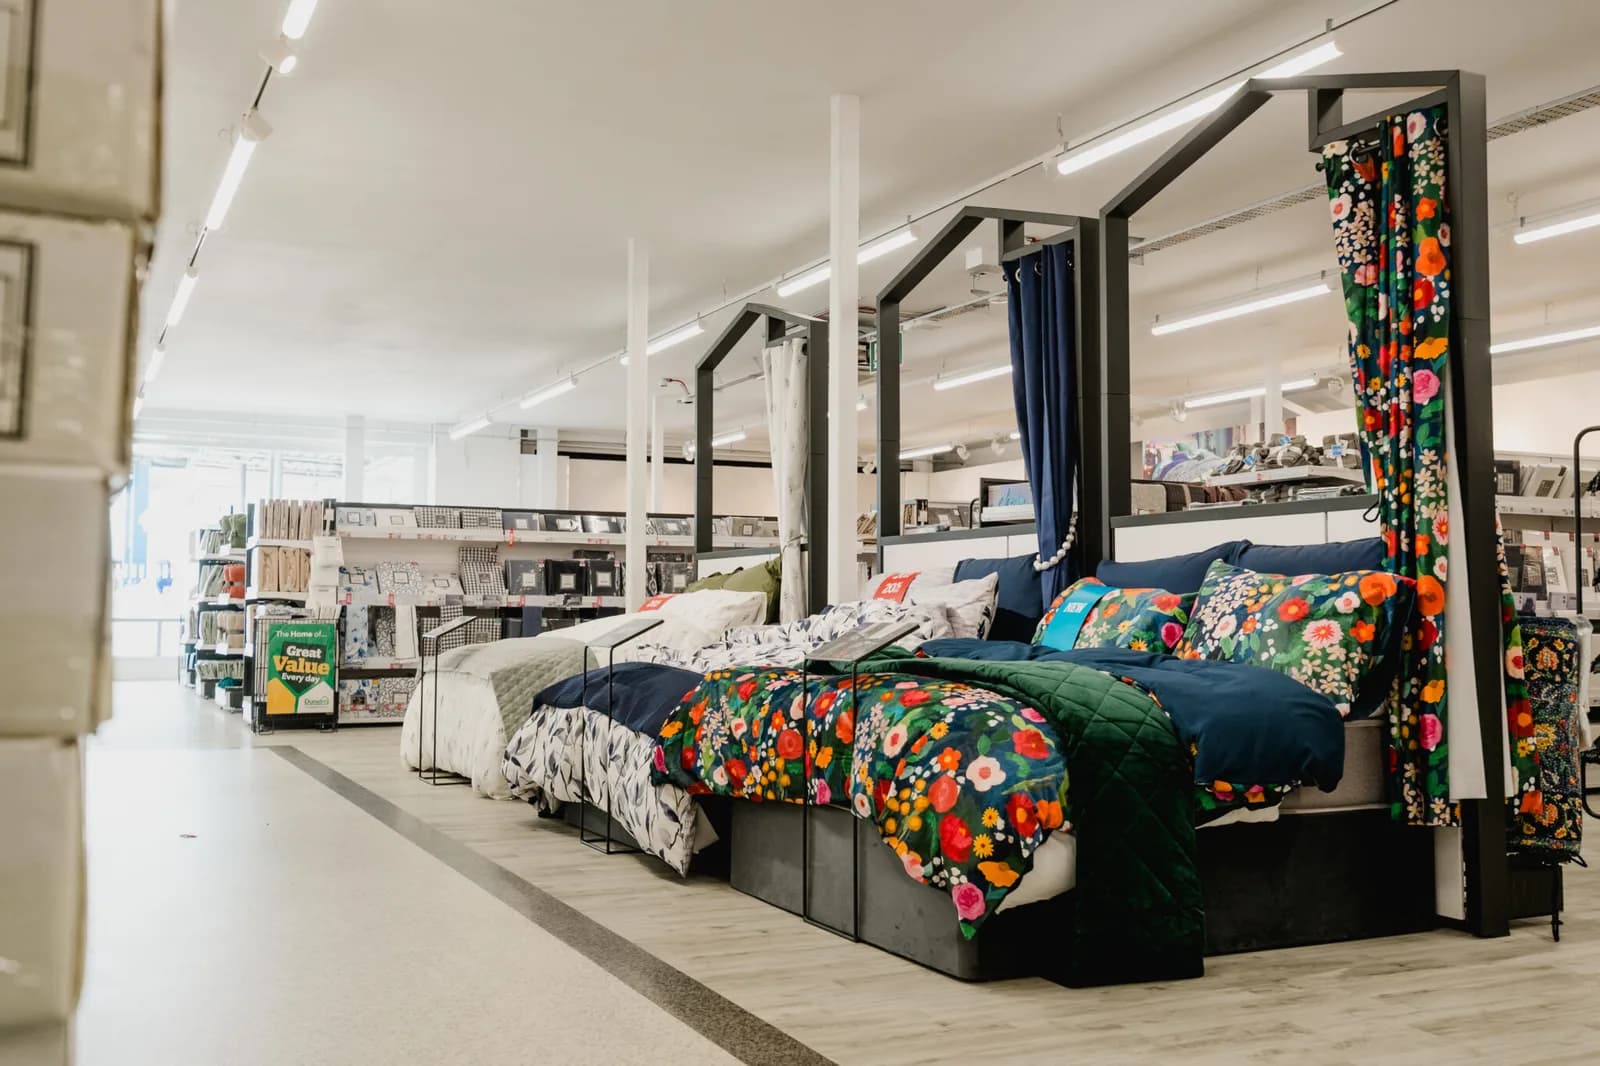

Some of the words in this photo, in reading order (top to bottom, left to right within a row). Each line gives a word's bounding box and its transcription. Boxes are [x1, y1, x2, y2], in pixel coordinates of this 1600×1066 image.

[275, 630, 289, 638] The
[290, 630, 313, 638] Home
[286, 645, 322, 659] Great
[273, 655, 330, 675] Value
[282, 672, 304, 683] Every
[305, 674, 321, 684] day
